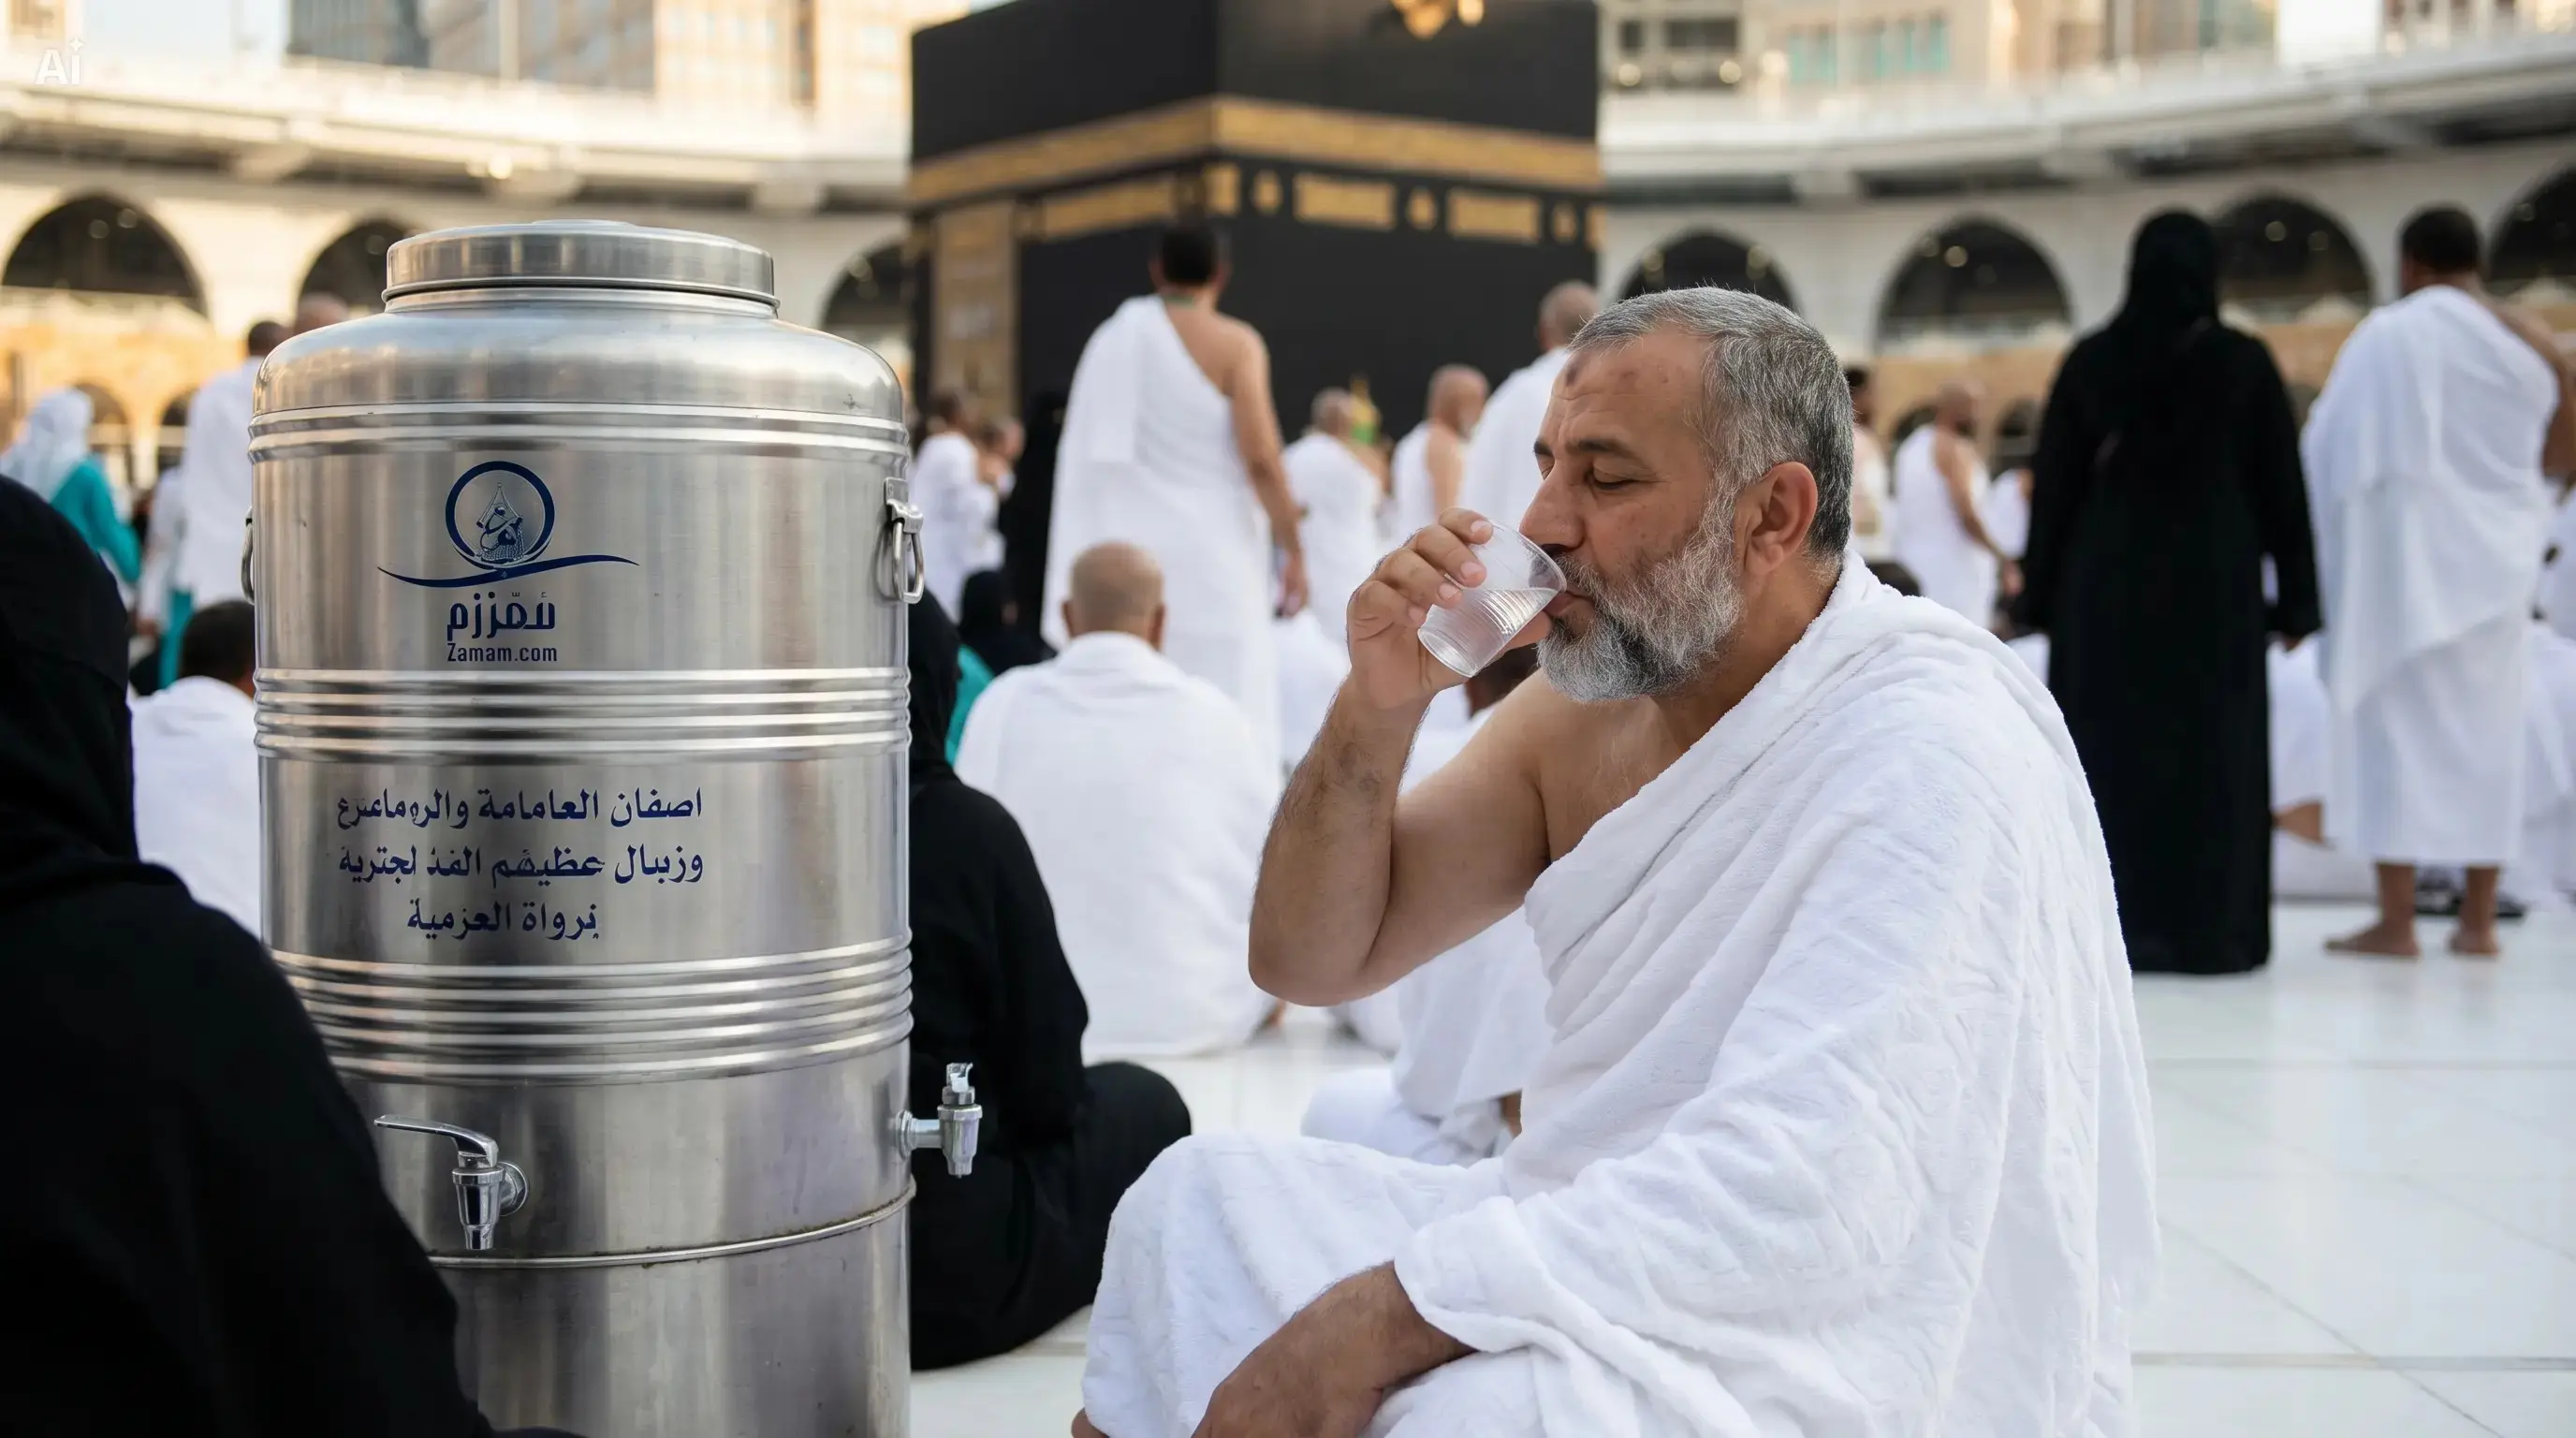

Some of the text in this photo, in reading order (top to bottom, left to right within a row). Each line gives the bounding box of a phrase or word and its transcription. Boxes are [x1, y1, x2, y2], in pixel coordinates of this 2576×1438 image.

[447, 642, 558, 662] Zamam.com
[477, 788, 599, 820] العامامة
[610, 787, 702, 828] اصفان
